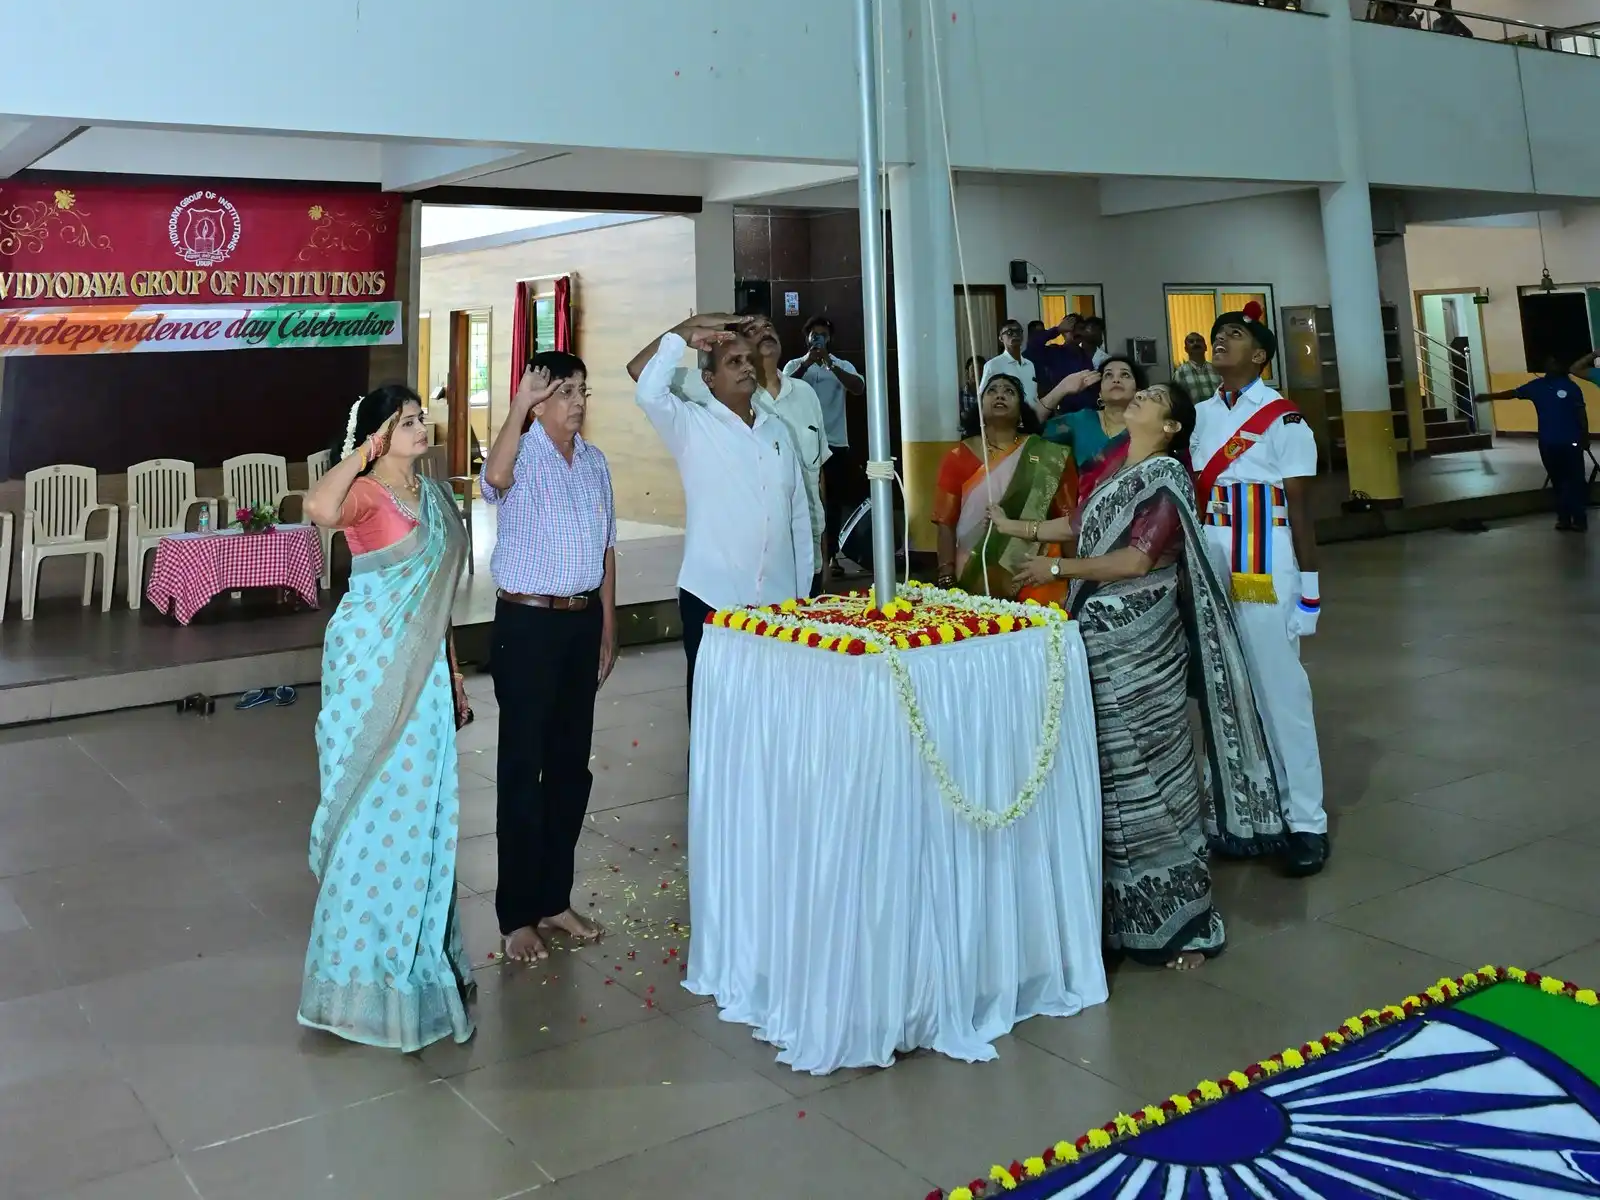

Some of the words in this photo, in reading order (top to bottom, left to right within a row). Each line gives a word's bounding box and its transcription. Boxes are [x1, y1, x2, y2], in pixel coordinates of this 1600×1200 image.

[169, 206, 183, 247] VIDYODAYA
[180, 191, 203, 207] GROUP
[205, 191, 216, 200] OF
[218, 197, 240, 251] INSTITUTIONS
[0, 271, 129, 299] VIDYODAYA
[130, 270, 207, 297] GROUP
[210, 270, 240, 296] OF
[242, 270, 386, 297] INSTITUTIONS
[0, 313, 222, 351] Independence
[224, 309, 278, 345] day
[278, 309, 395, 339] Celebration
